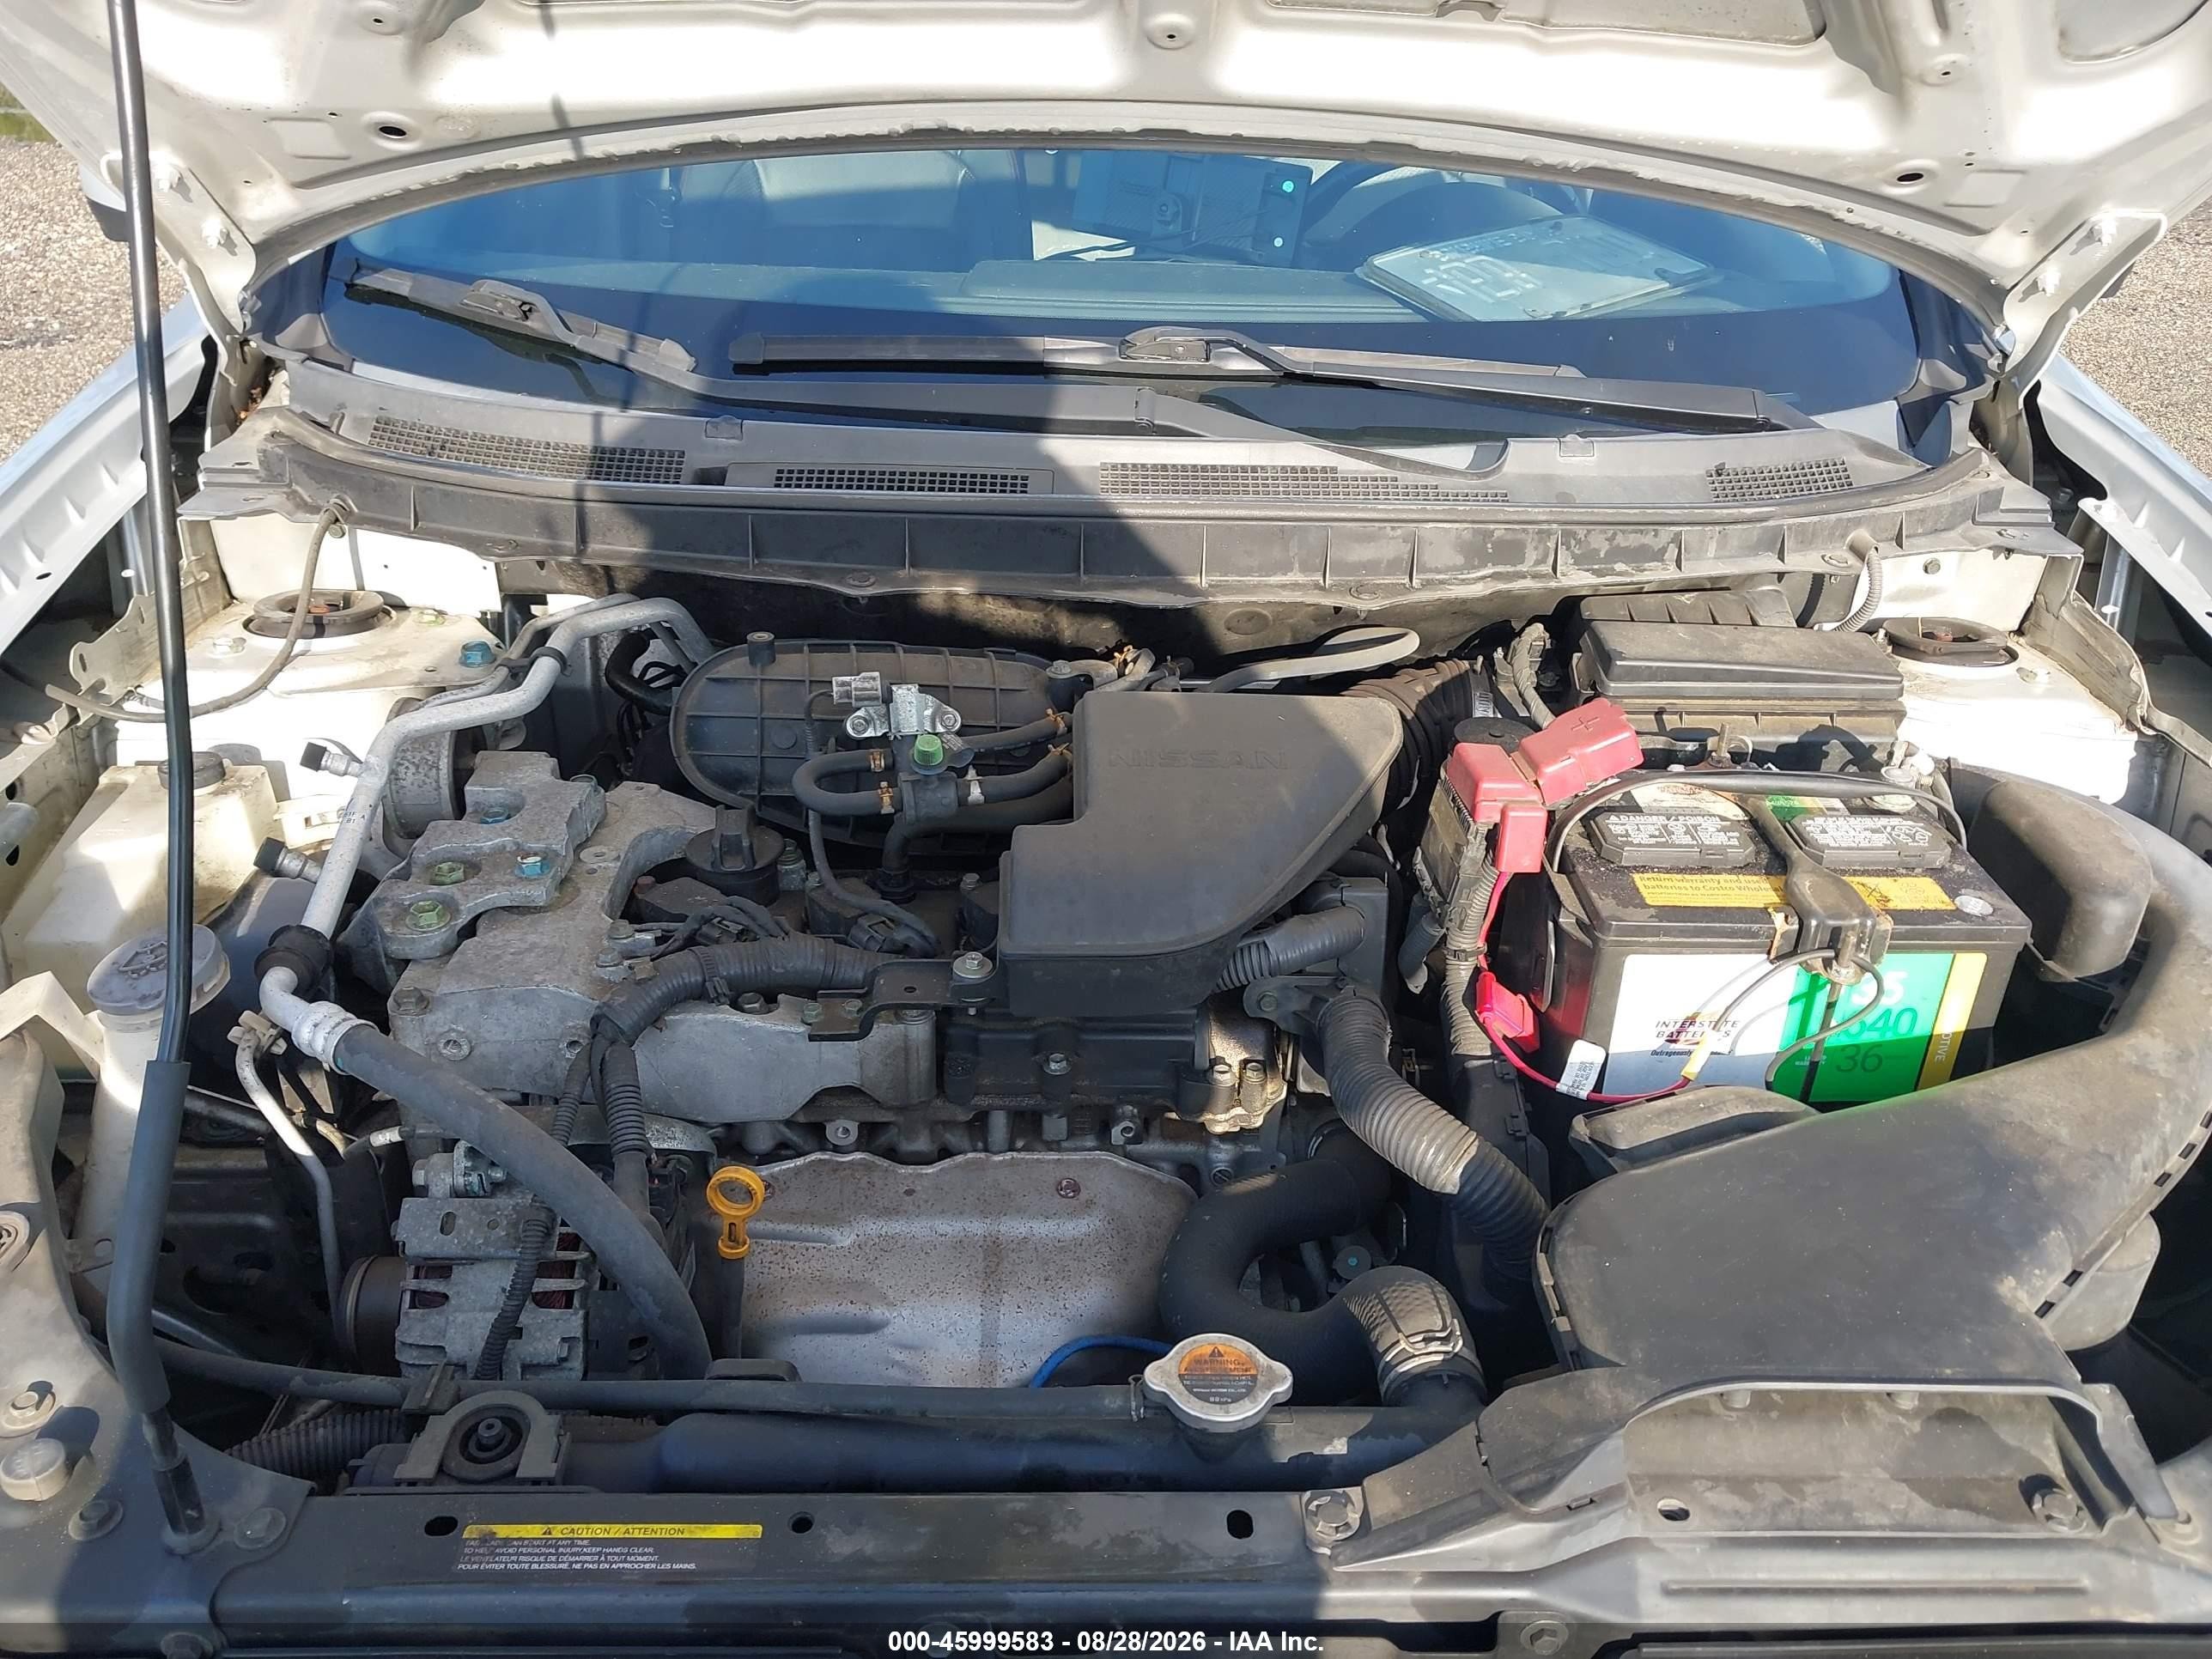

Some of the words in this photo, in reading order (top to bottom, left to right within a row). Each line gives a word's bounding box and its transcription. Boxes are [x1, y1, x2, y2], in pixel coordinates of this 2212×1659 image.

[1109, 749, 1289, 770] NISSAN
[1675, 878, 1721, 886] warranty
[1644, 884, 1689, 892] batteries
[1656, 1020, 1739, 1030] INTERSTTE
[1834, 1043, 1884, 1073] 36
[560, 1528, 610, 1536] CAUTION
[623, 1528, 686, 1536] ATTENTION
